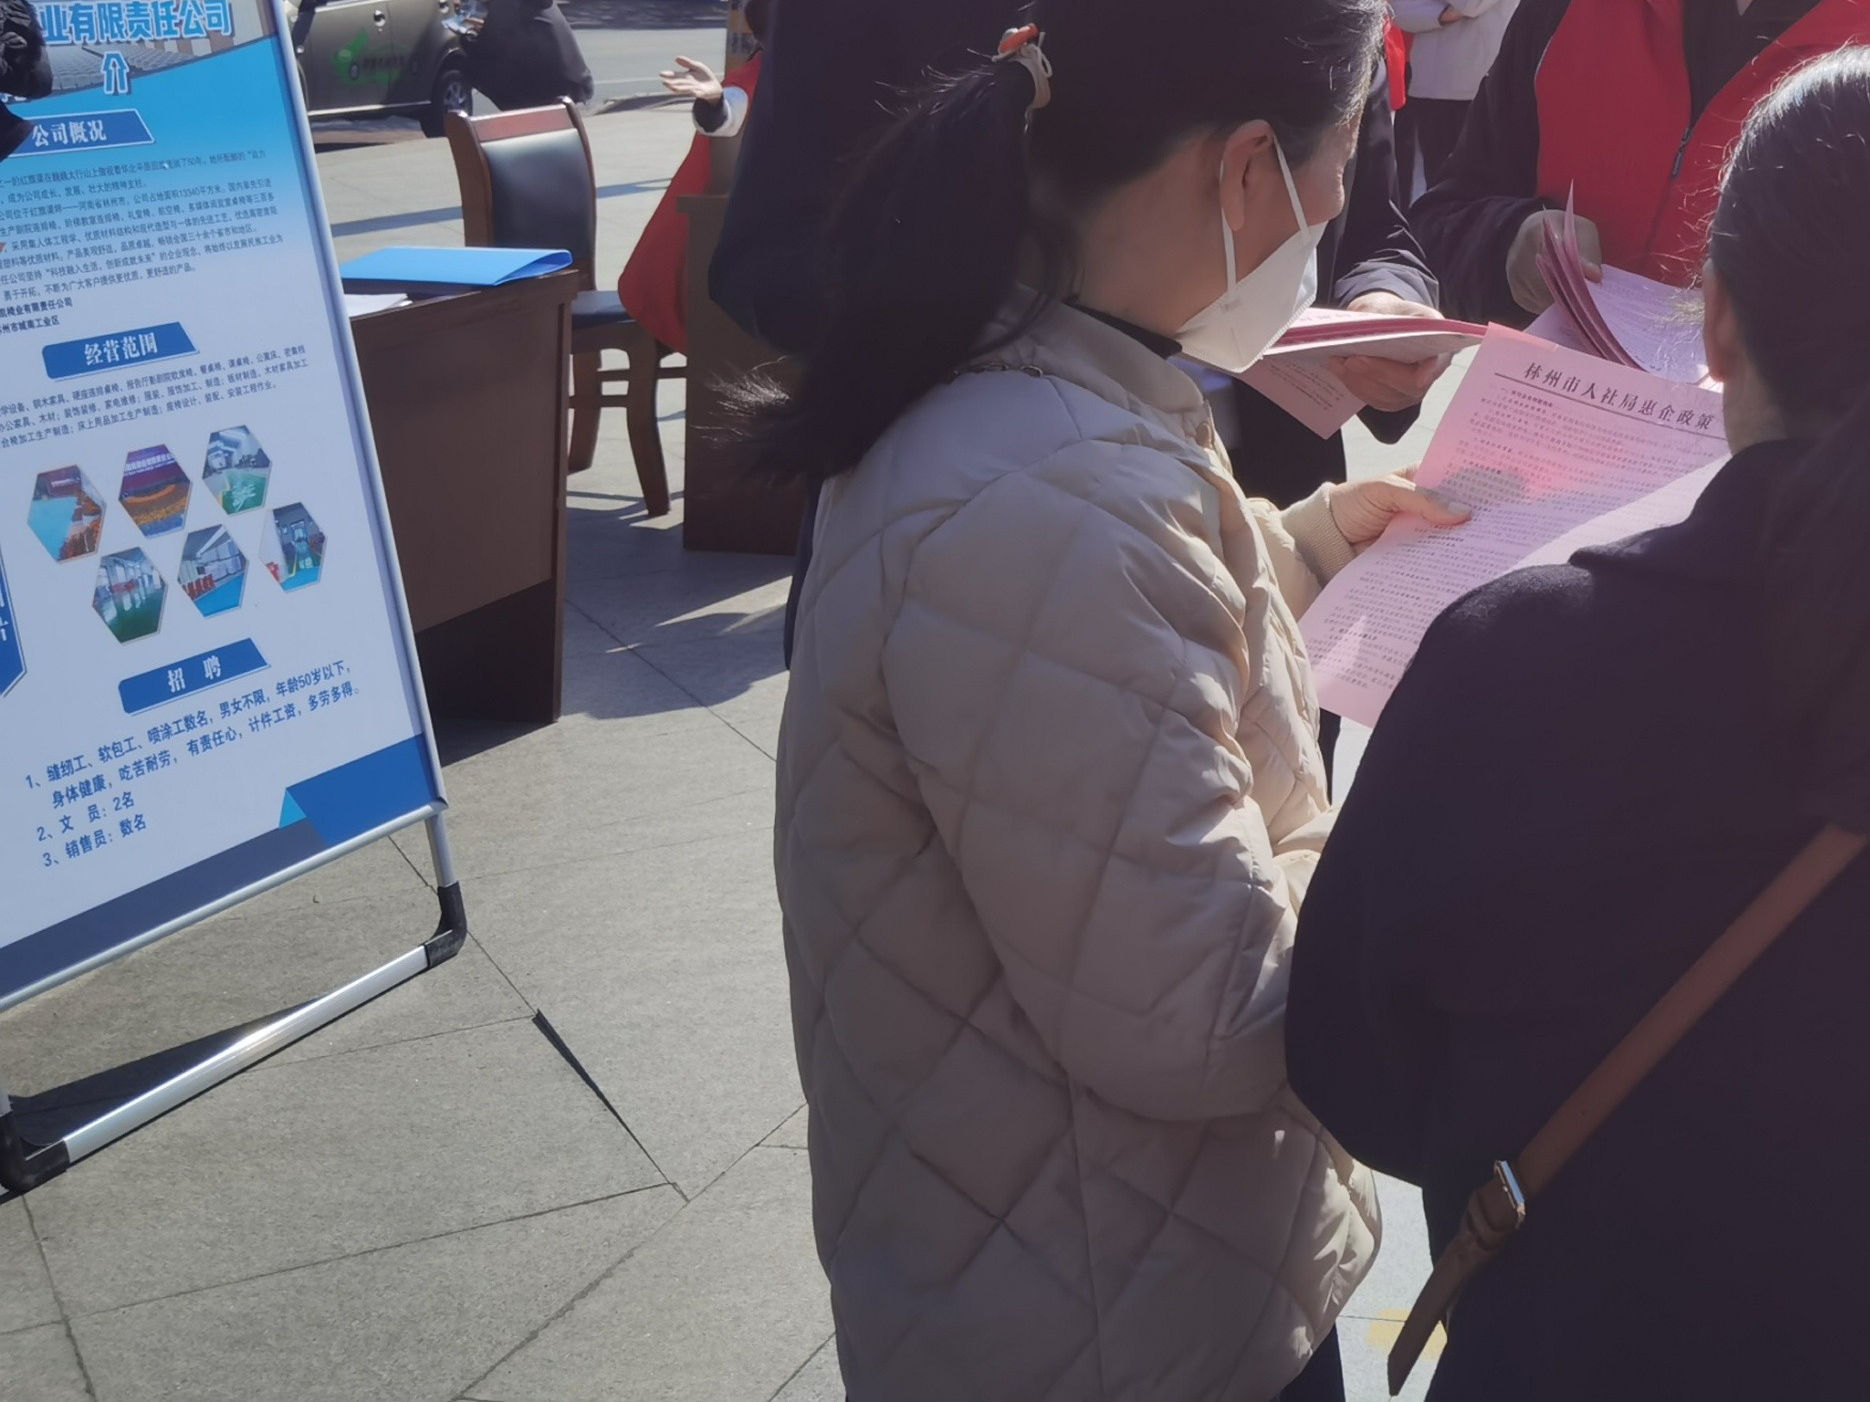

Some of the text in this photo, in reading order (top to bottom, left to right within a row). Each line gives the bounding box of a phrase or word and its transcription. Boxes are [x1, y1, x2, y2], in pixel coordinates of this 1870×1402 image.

[32, 118, 107, 148] 公司概况
[83, 331, 159, 367] 经营范围
